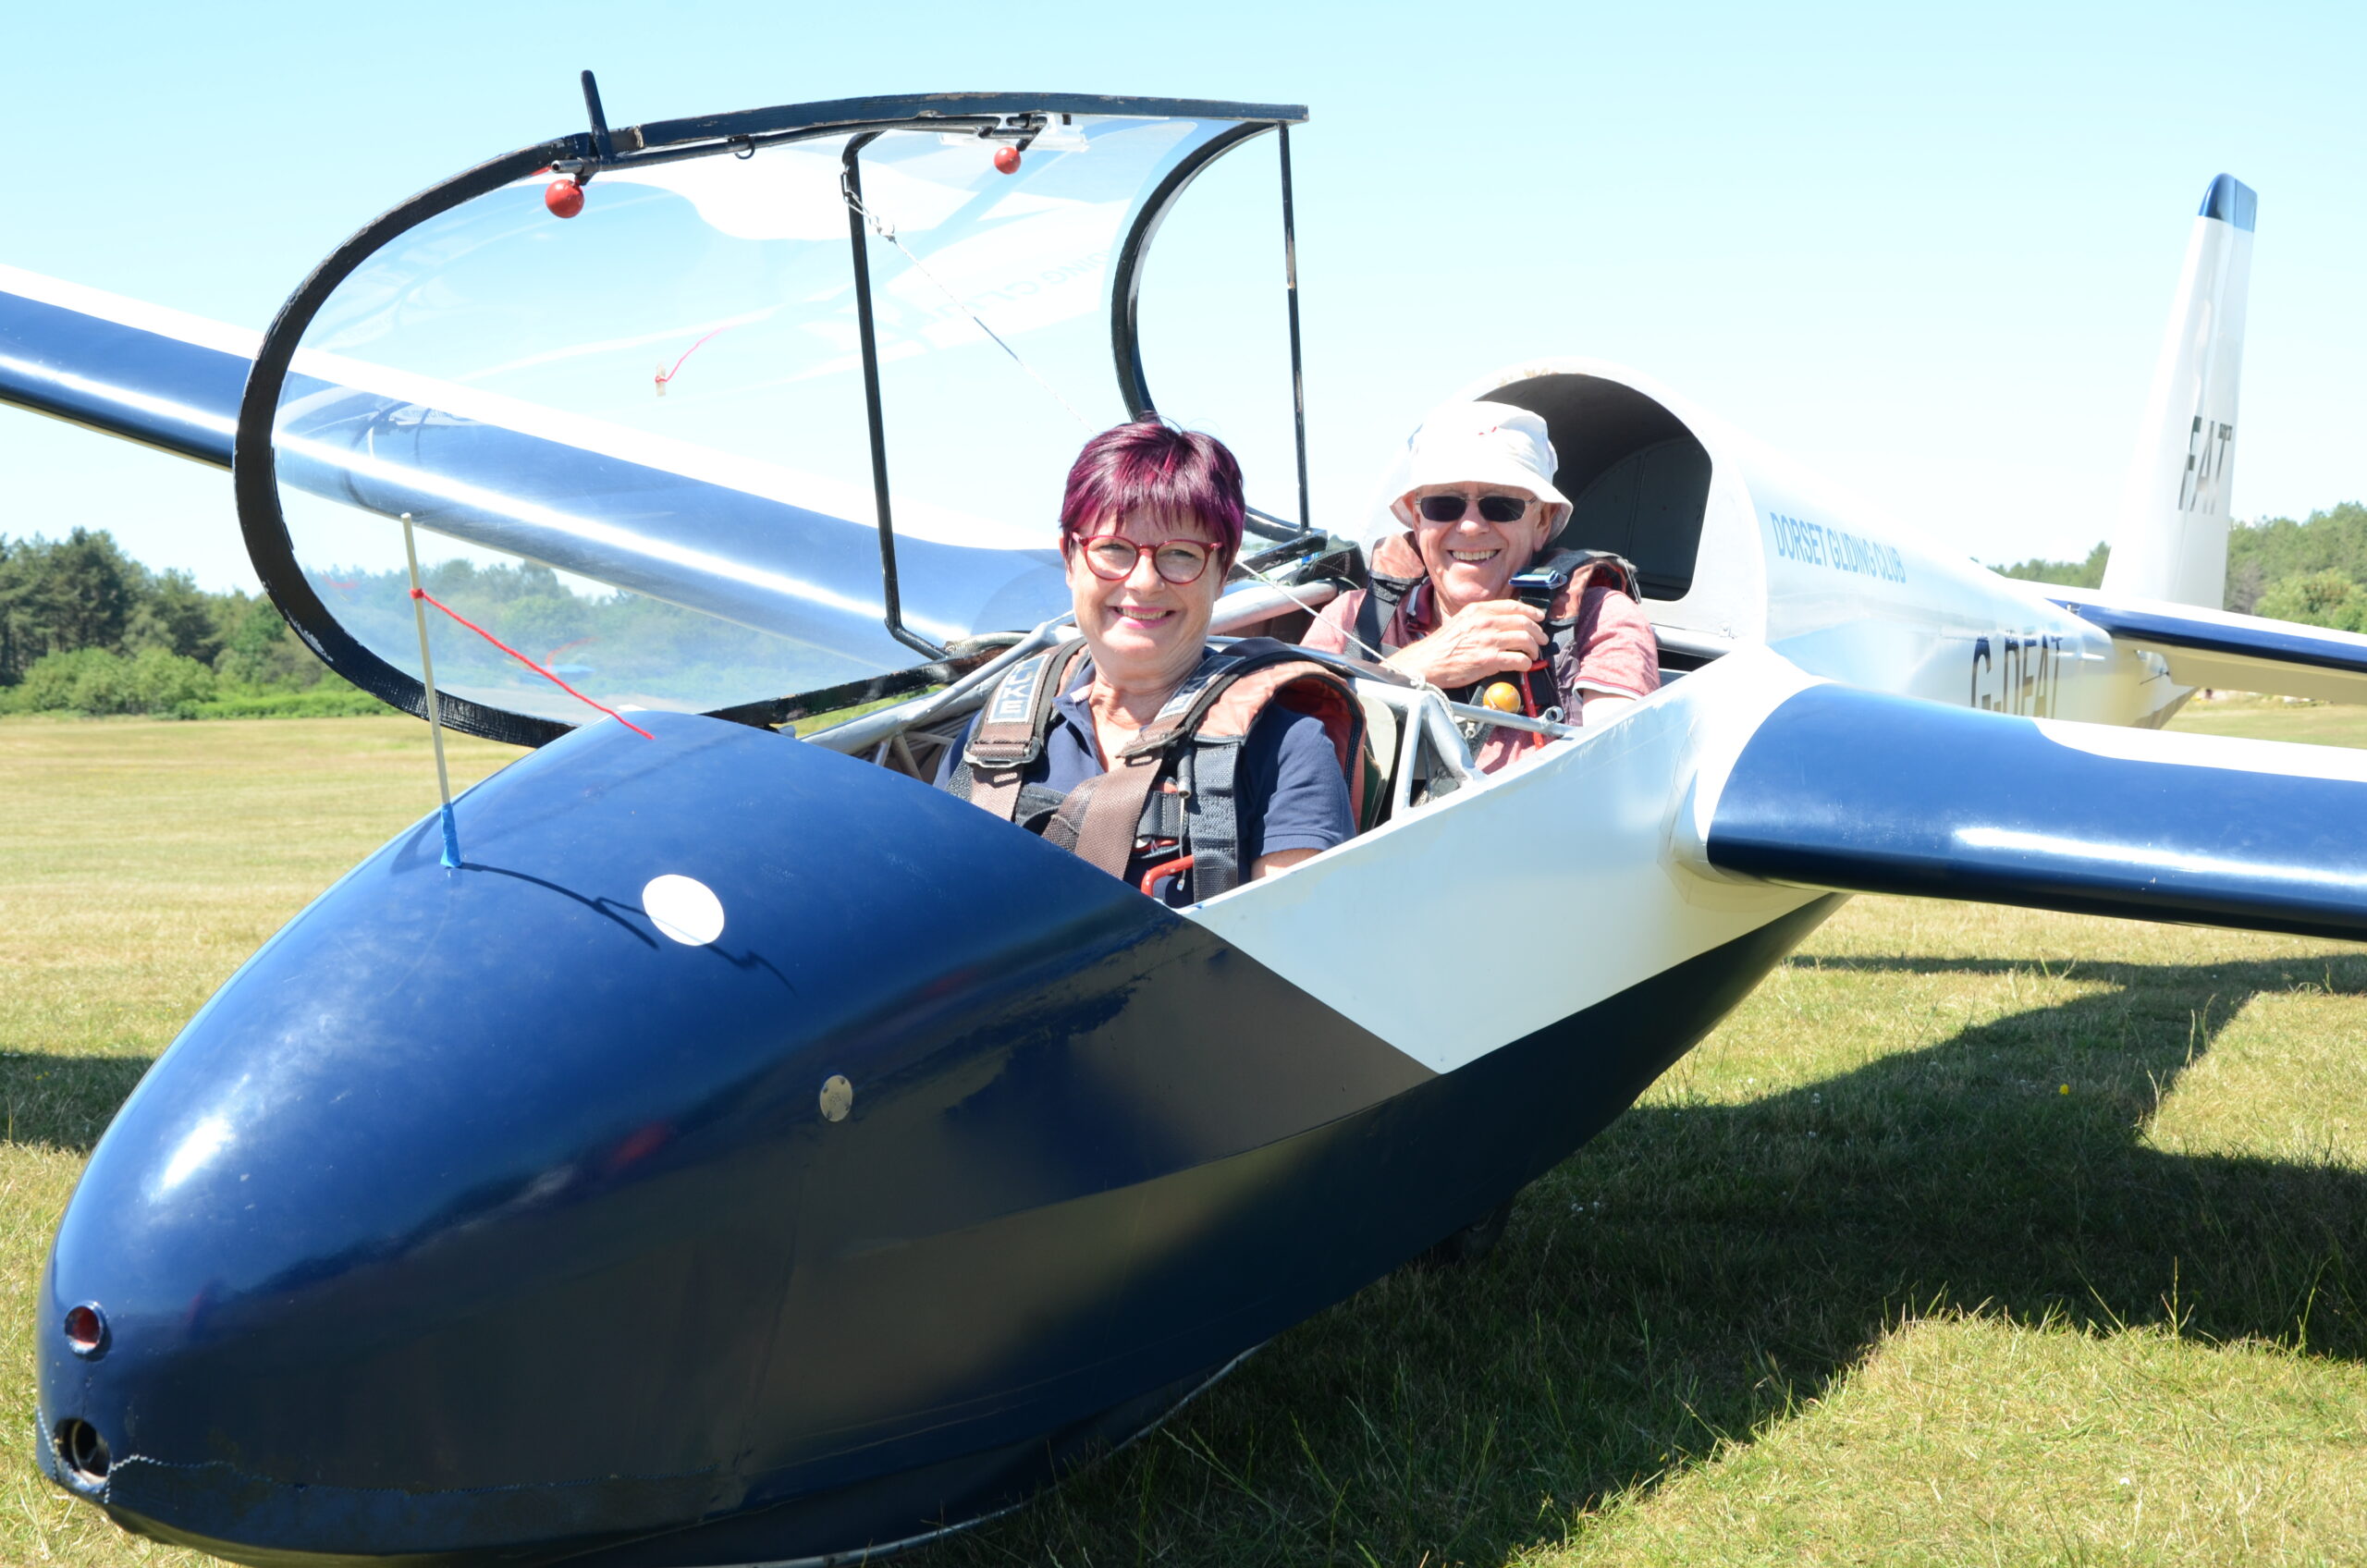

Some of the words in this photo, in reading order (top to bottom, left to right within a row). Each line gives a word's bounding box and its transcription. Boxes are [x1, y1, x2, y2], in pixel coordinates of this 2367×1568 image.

[2178, 415, 2233, 515] FAT
[1770, 512, 1828, 567] DORSET
[1827, 527, 1877, 577] GLIDING
[1872, 541, 1907, 583] CLUB
